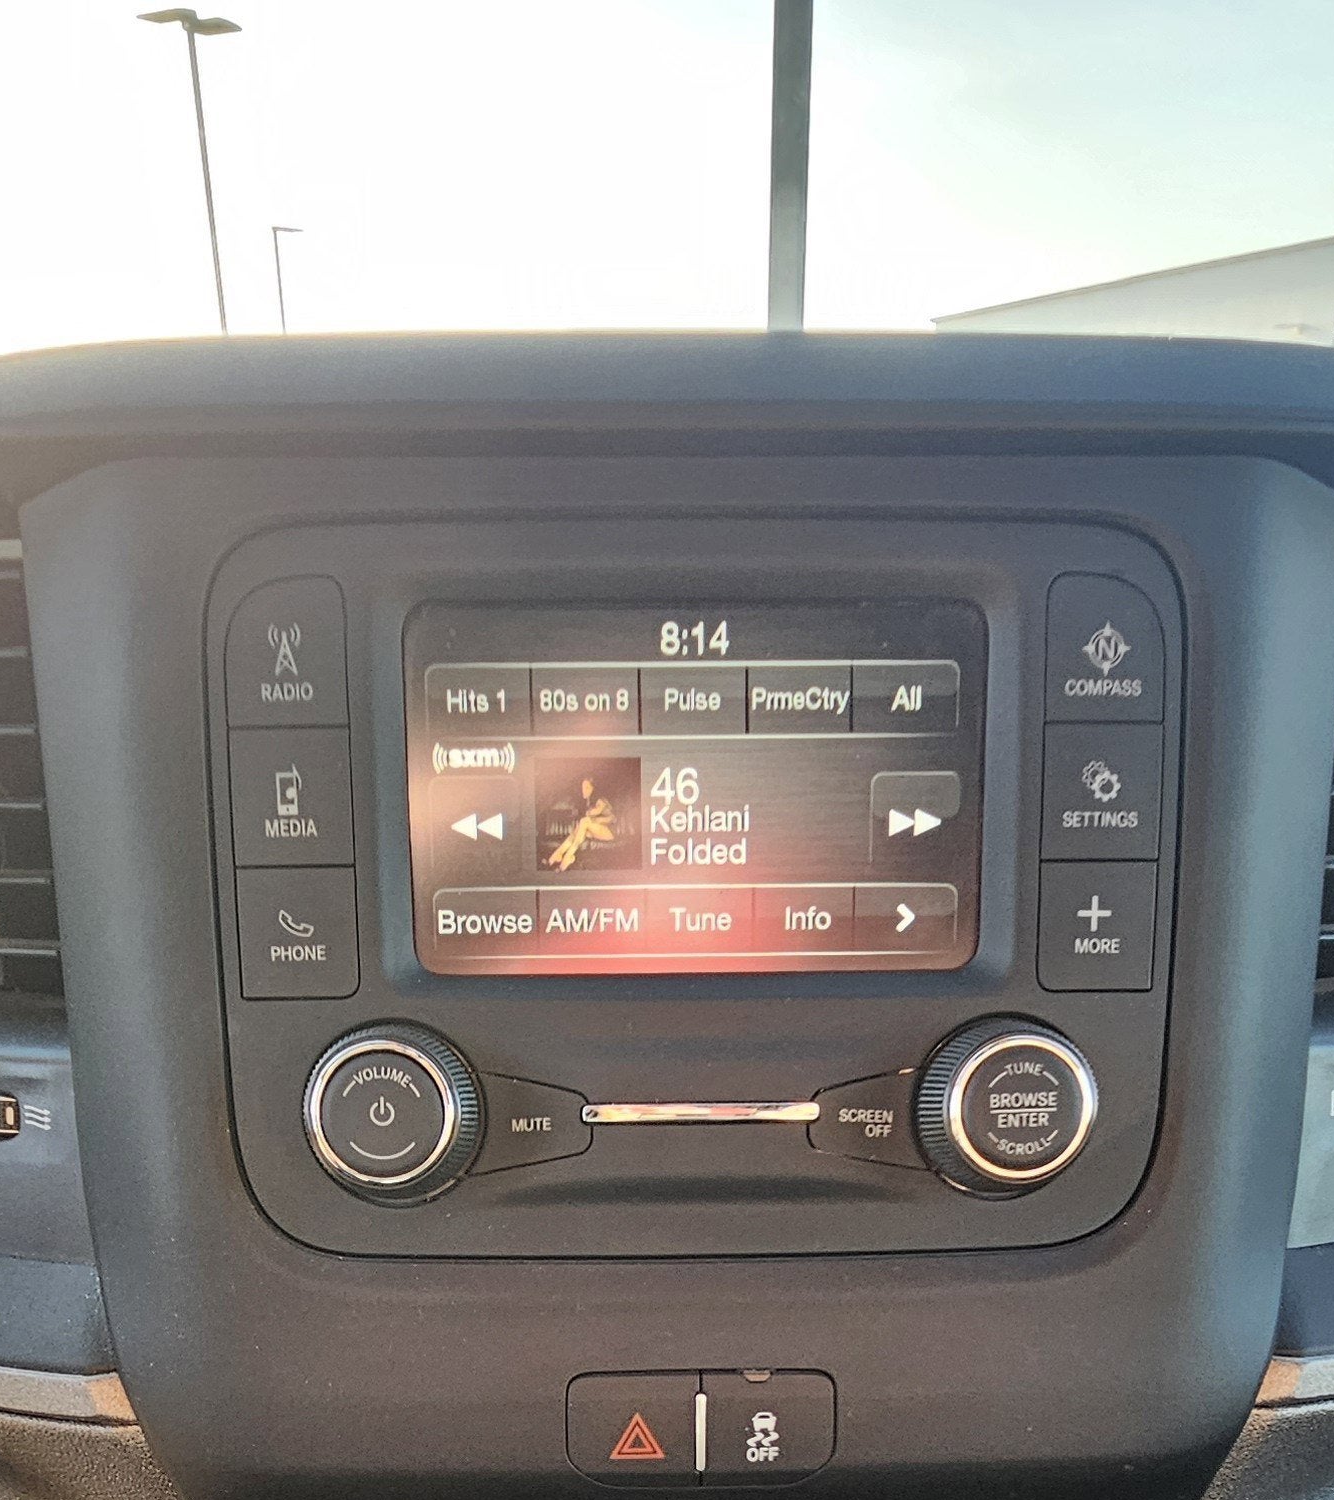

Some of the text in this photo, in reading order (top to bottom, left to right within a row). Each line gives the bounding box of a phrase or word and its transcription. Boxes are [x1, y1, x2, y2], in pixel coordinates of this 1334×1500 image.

[660, 620, 729, 656] 8:14
[261, 682, 313, 702] RADIO
[890, 685, 922, 712] All
[1064, 678, 1142, 698] COMPASS
[446, 688, 506, 713] Hits 1
[540, 688, 629, 712] 80s on 8
[664, 687, 721, 712] Pulse
[751, 686, 850, 715] PrmeCtry
[650, 766, 699, 806] 46
[265, 818, 317, 838] MEDIA
[650, 805, 750, 834] Kehlani
[1062, 810, 1139, 829] SETTINGS
[650, 838, 747, 866] Folded
[437, 909, 533, 935] Browse
[545, 908, 639, 934] AM/FM
[668, 907, 733, 932] Tune
[784, 906, 832, 931] Info
[270, 945, 326, 962] PHONE
[1074, 938, 1120, 955] MORE
[353, 1066, 412, 1088] VOLUME
[1005, 1062, 1045, 1077] TUNE
[989, 1091, 1059, 1109] BROWSE
[511, 1117, 552, 1133] MUTE
[838, 1108, 894, 1124] SCREEN
[997, 1112, 1050, 1129] ENTER
[864, 1123, 893, 1138] OFF
[996, 1137, 1052, 1156] SCROLL
[746, 1446, 780, 1463] OFF
